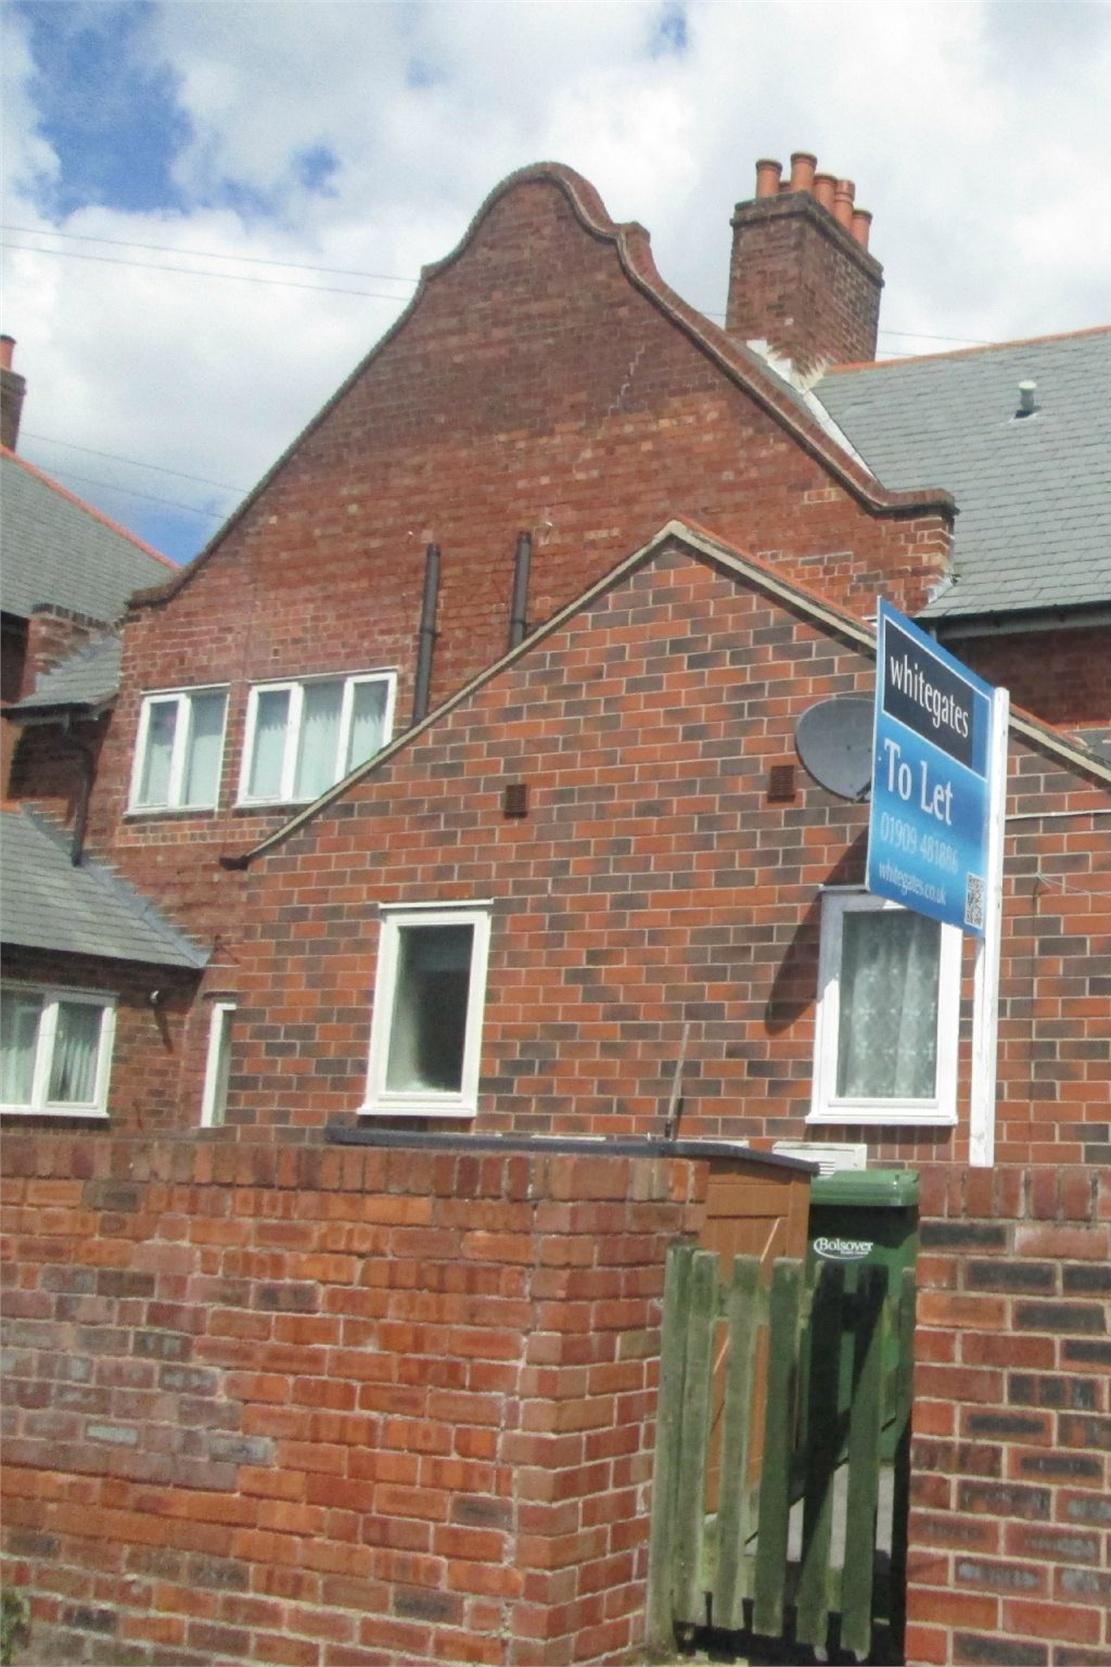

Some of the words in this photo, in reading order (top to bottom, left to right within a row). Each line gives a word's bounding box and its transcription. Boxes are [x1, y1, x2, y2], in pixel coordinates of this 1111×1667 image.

[889, 654, 969, 738] whitegates
[883, 738, 912, 801] To
[919, 760, 954, 826] Let
[880, 812, 918, 854] 01909
[878, 858, 947, 906] whitegates.co.uk
[818, 1237, 874, 1252] Bolsover
